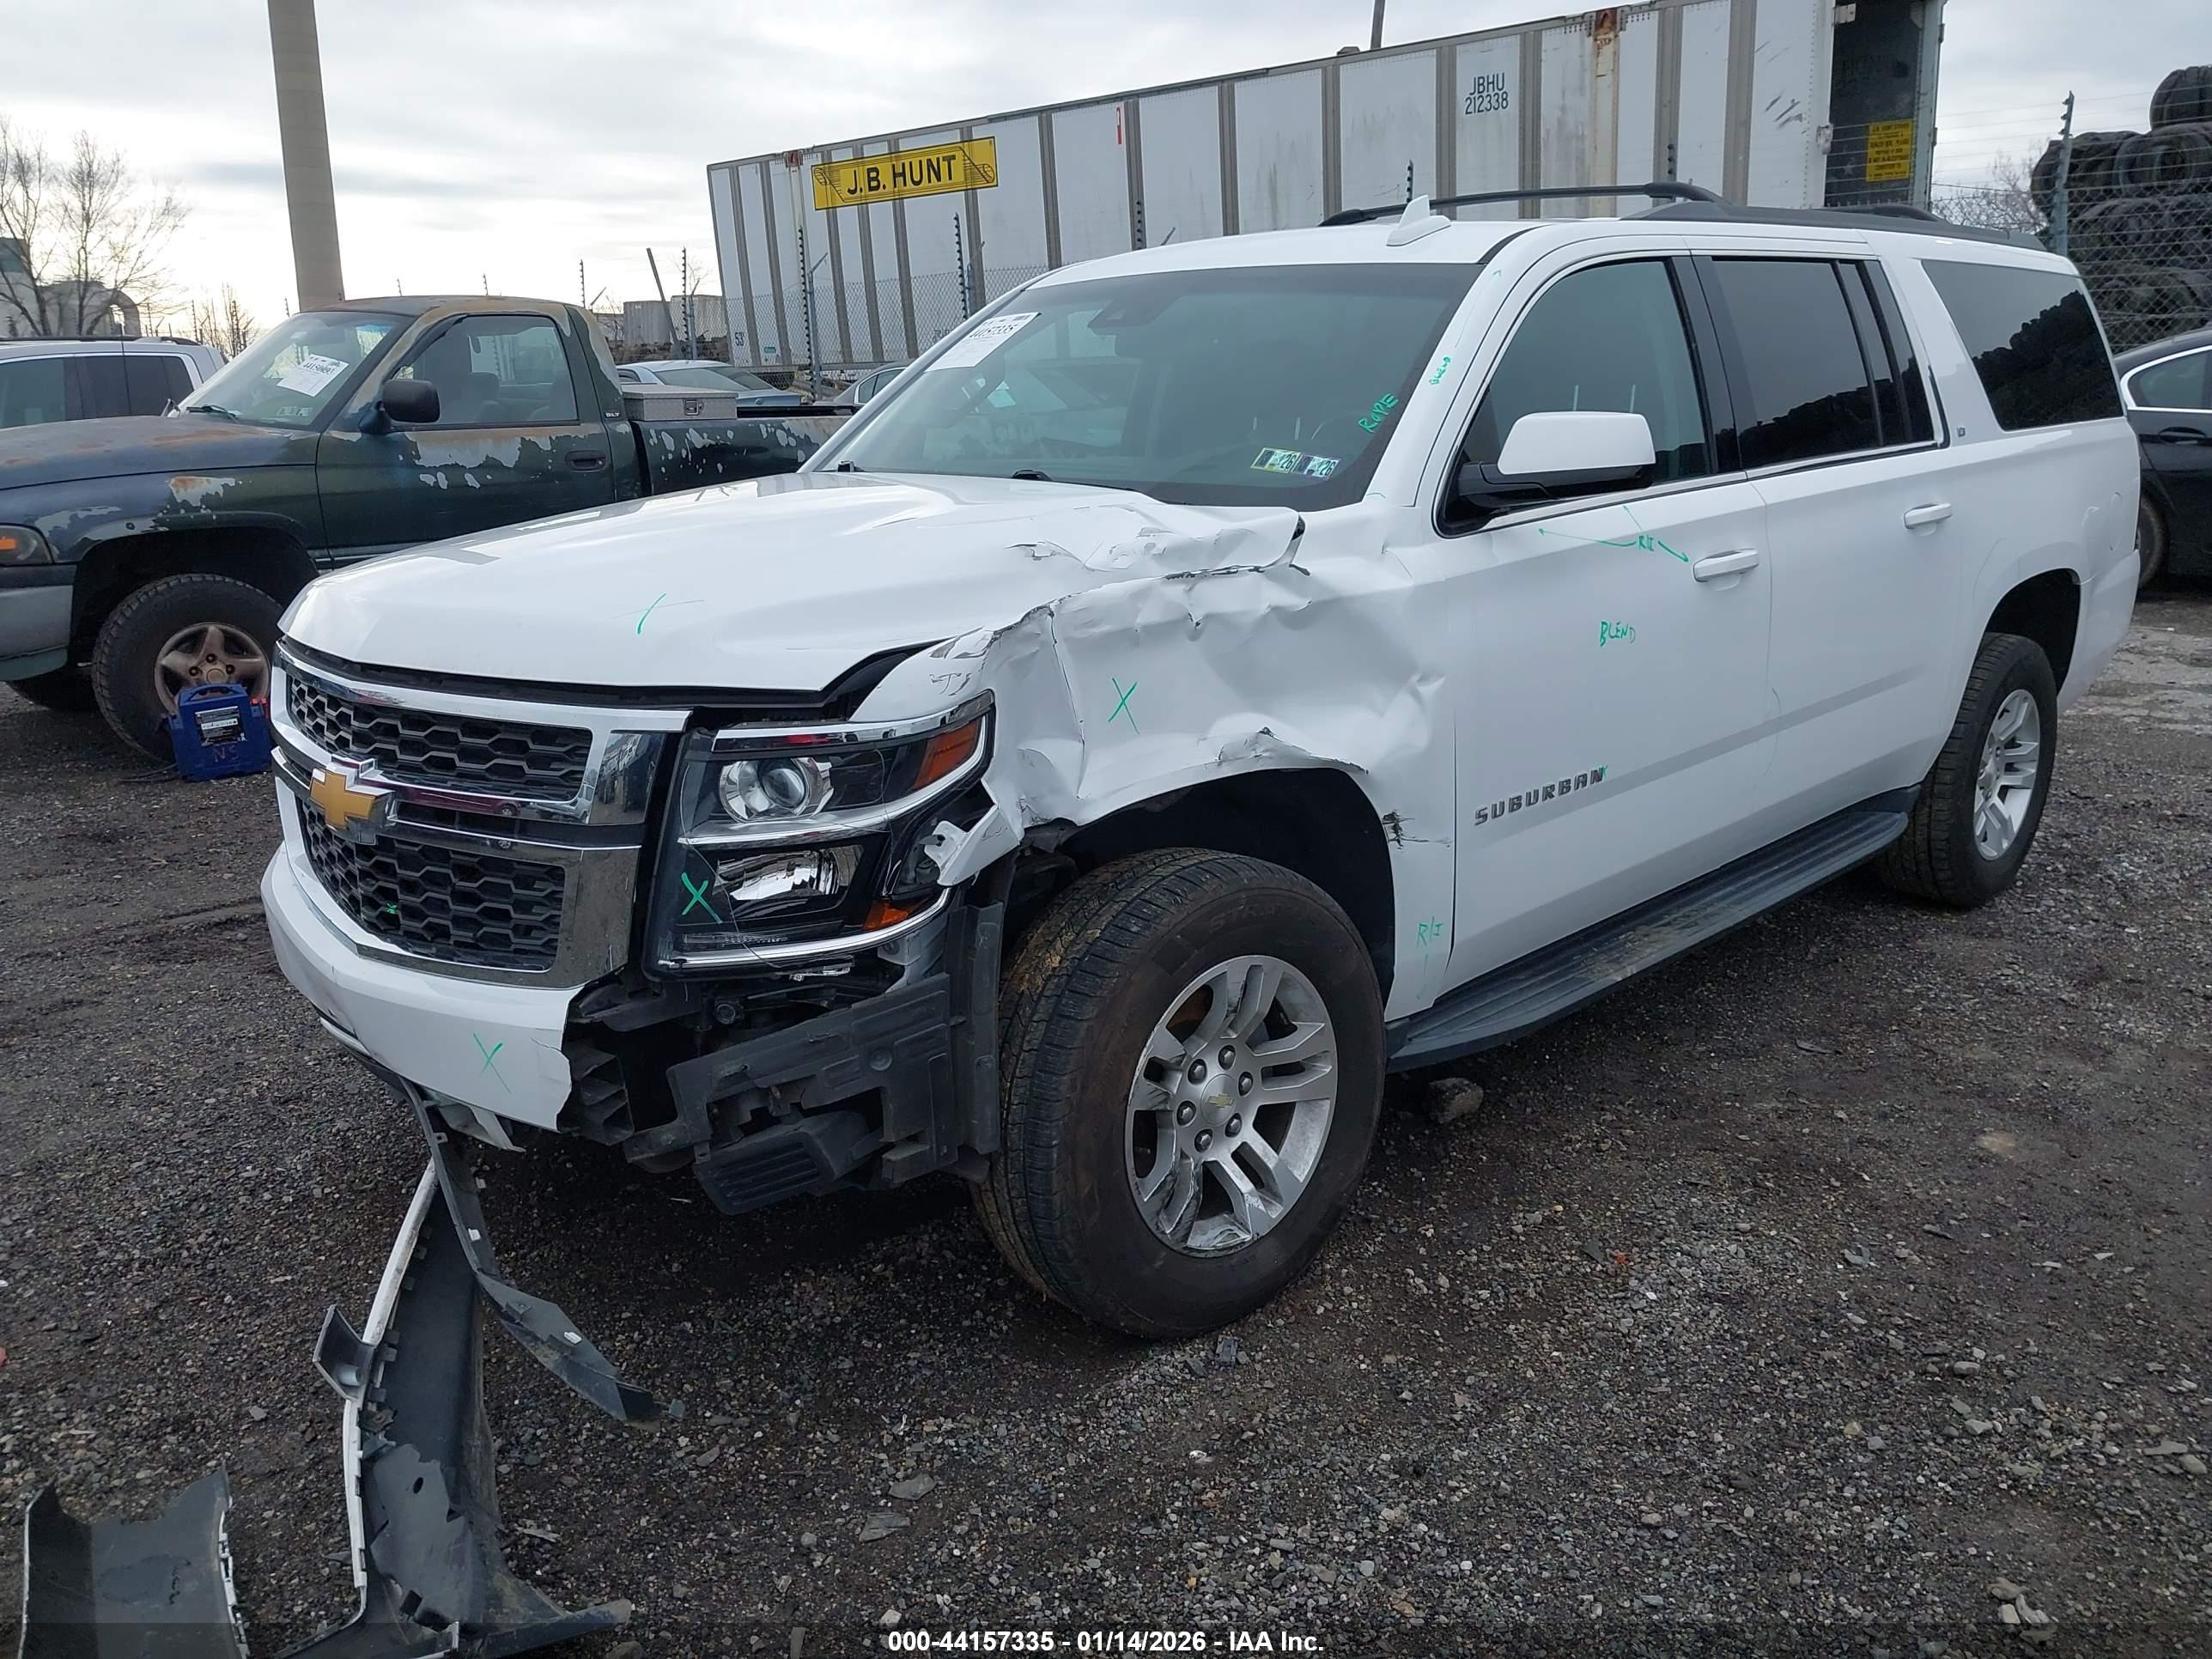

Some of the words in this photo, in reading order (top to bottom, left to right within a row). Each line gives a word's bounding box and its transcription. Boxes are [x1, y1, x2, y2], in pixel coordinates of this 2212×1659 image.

[1469, 72, 1504, 95] JBHU
[1464, 91, 1509, 115] 212338
[892, 155, 957, 188] HUNT
[1474, 766, 1604, 826] SUBURBAN
